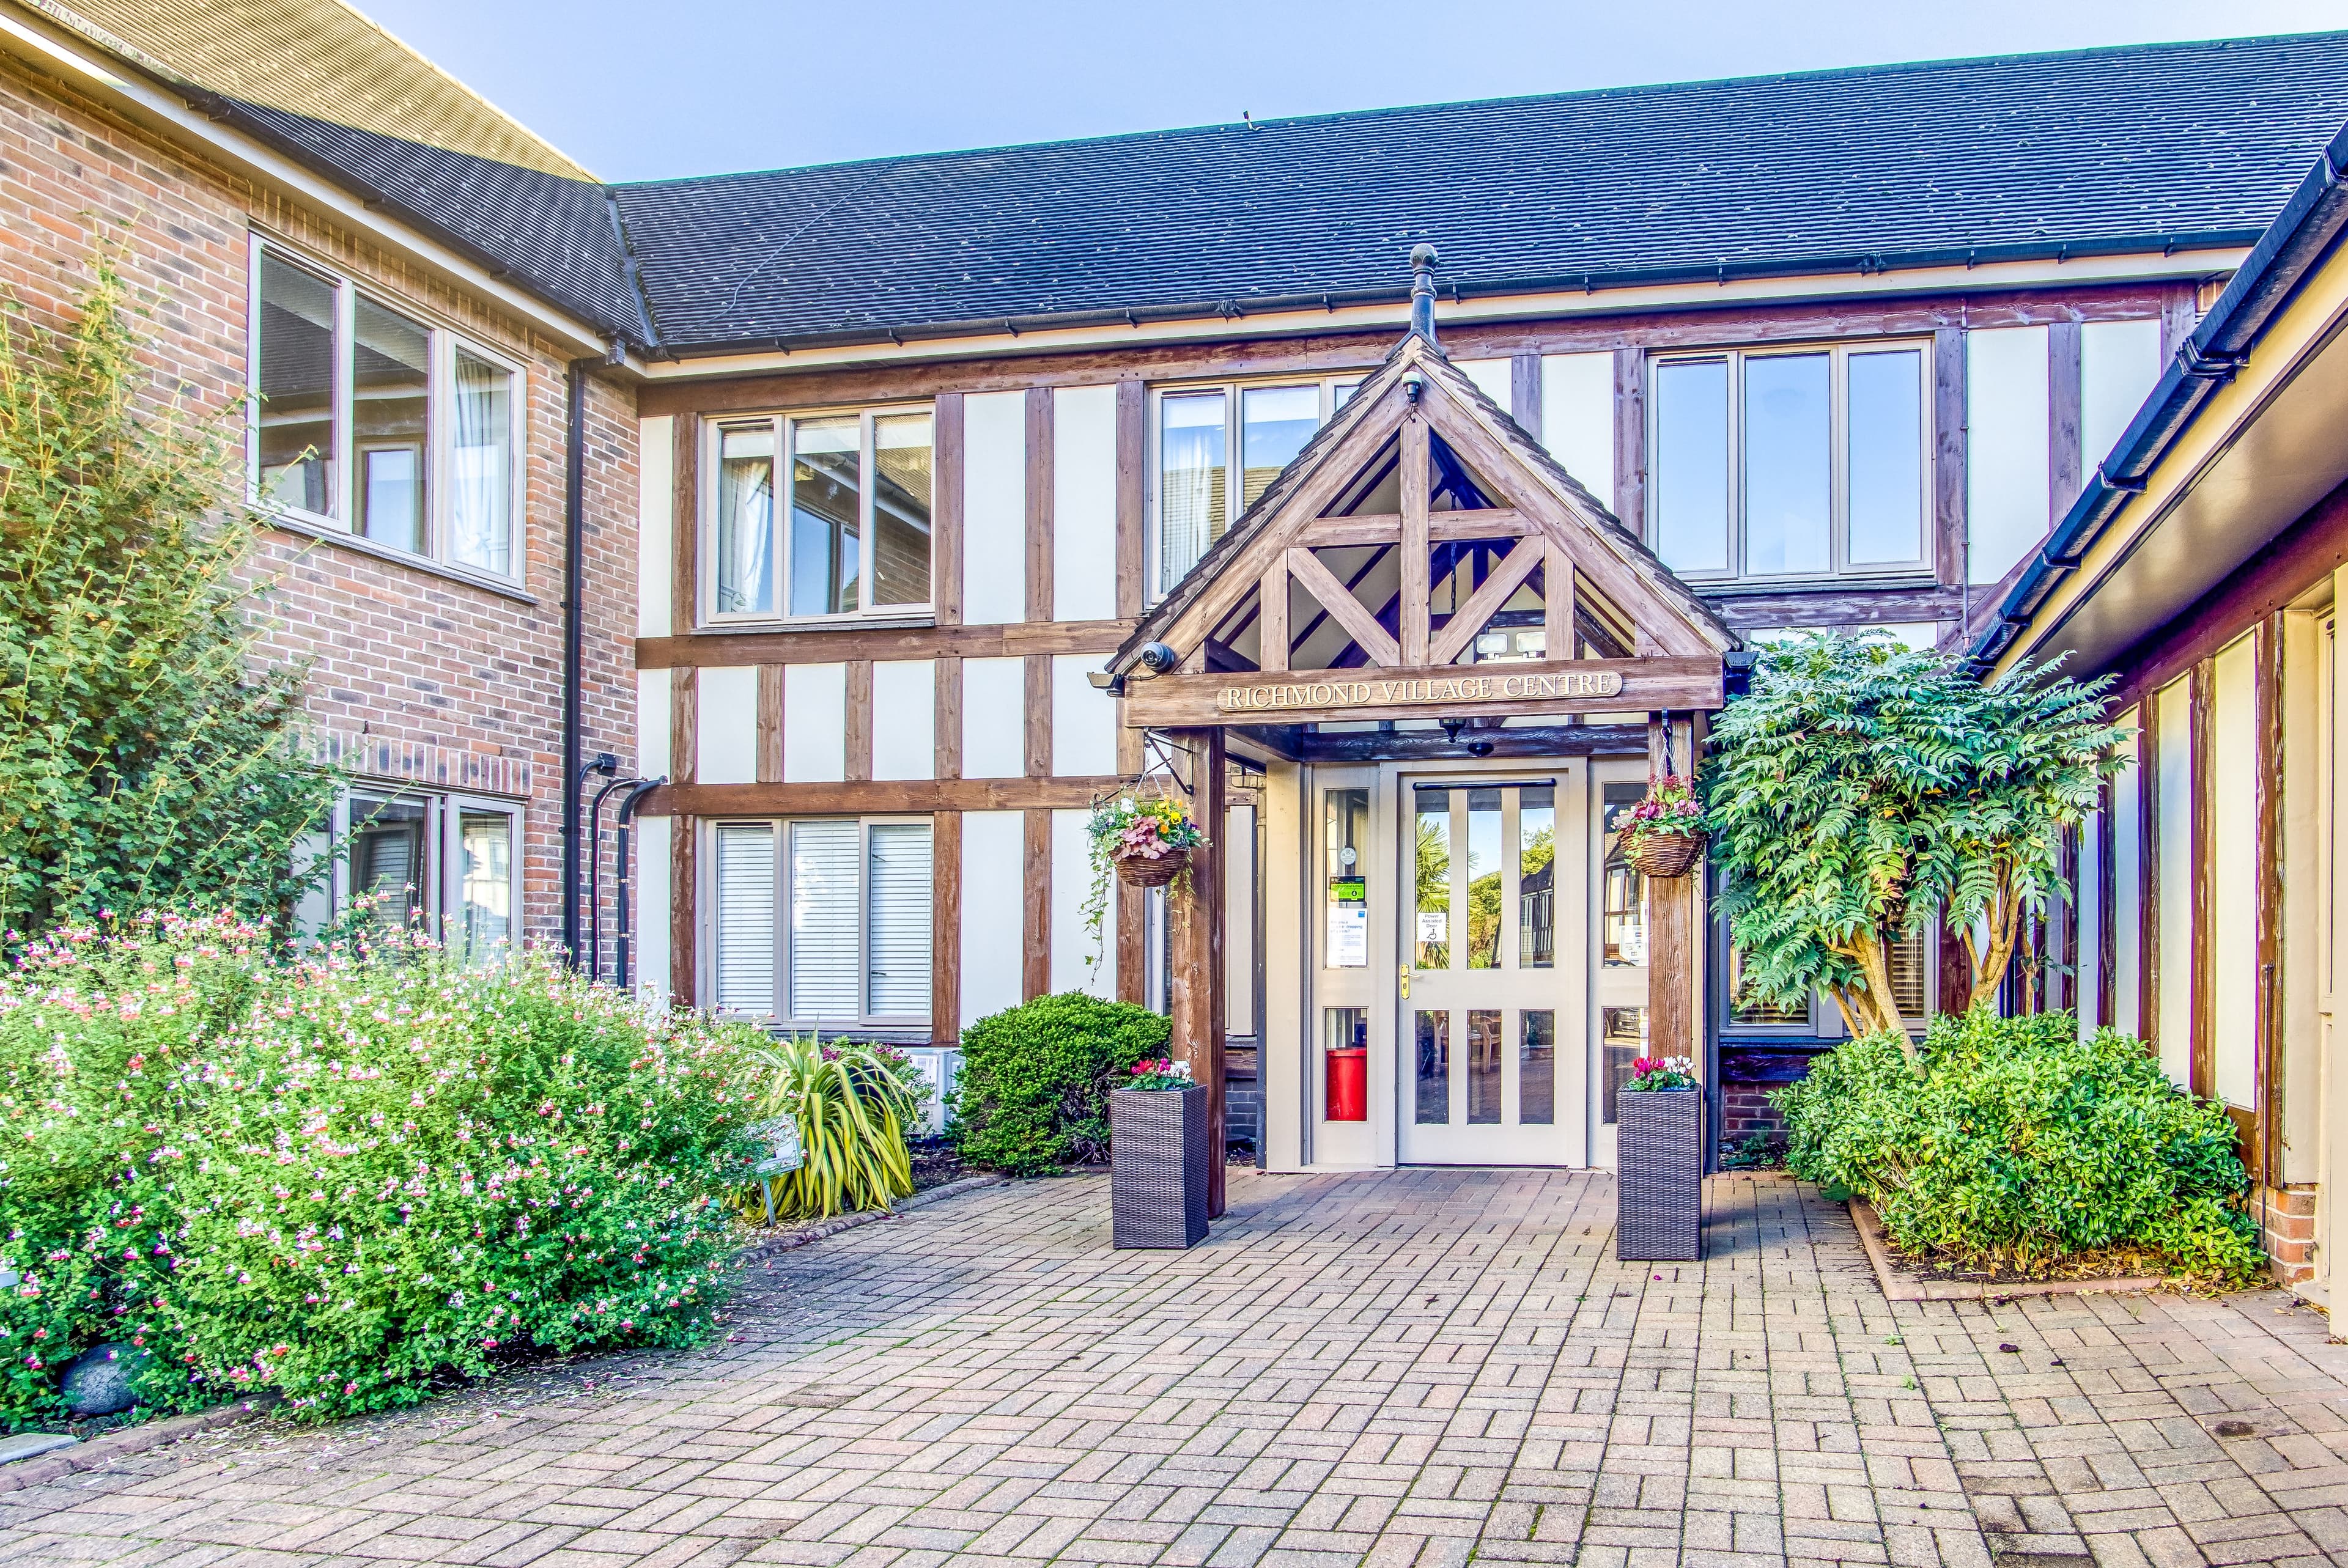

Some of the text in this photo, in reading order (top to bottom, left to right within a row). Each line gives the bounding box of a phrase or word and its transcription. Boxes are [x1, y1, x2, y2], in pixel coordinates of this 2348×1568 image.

[1225, 673, 1612, 709] RICHMOND VILLAGE CENTRE
